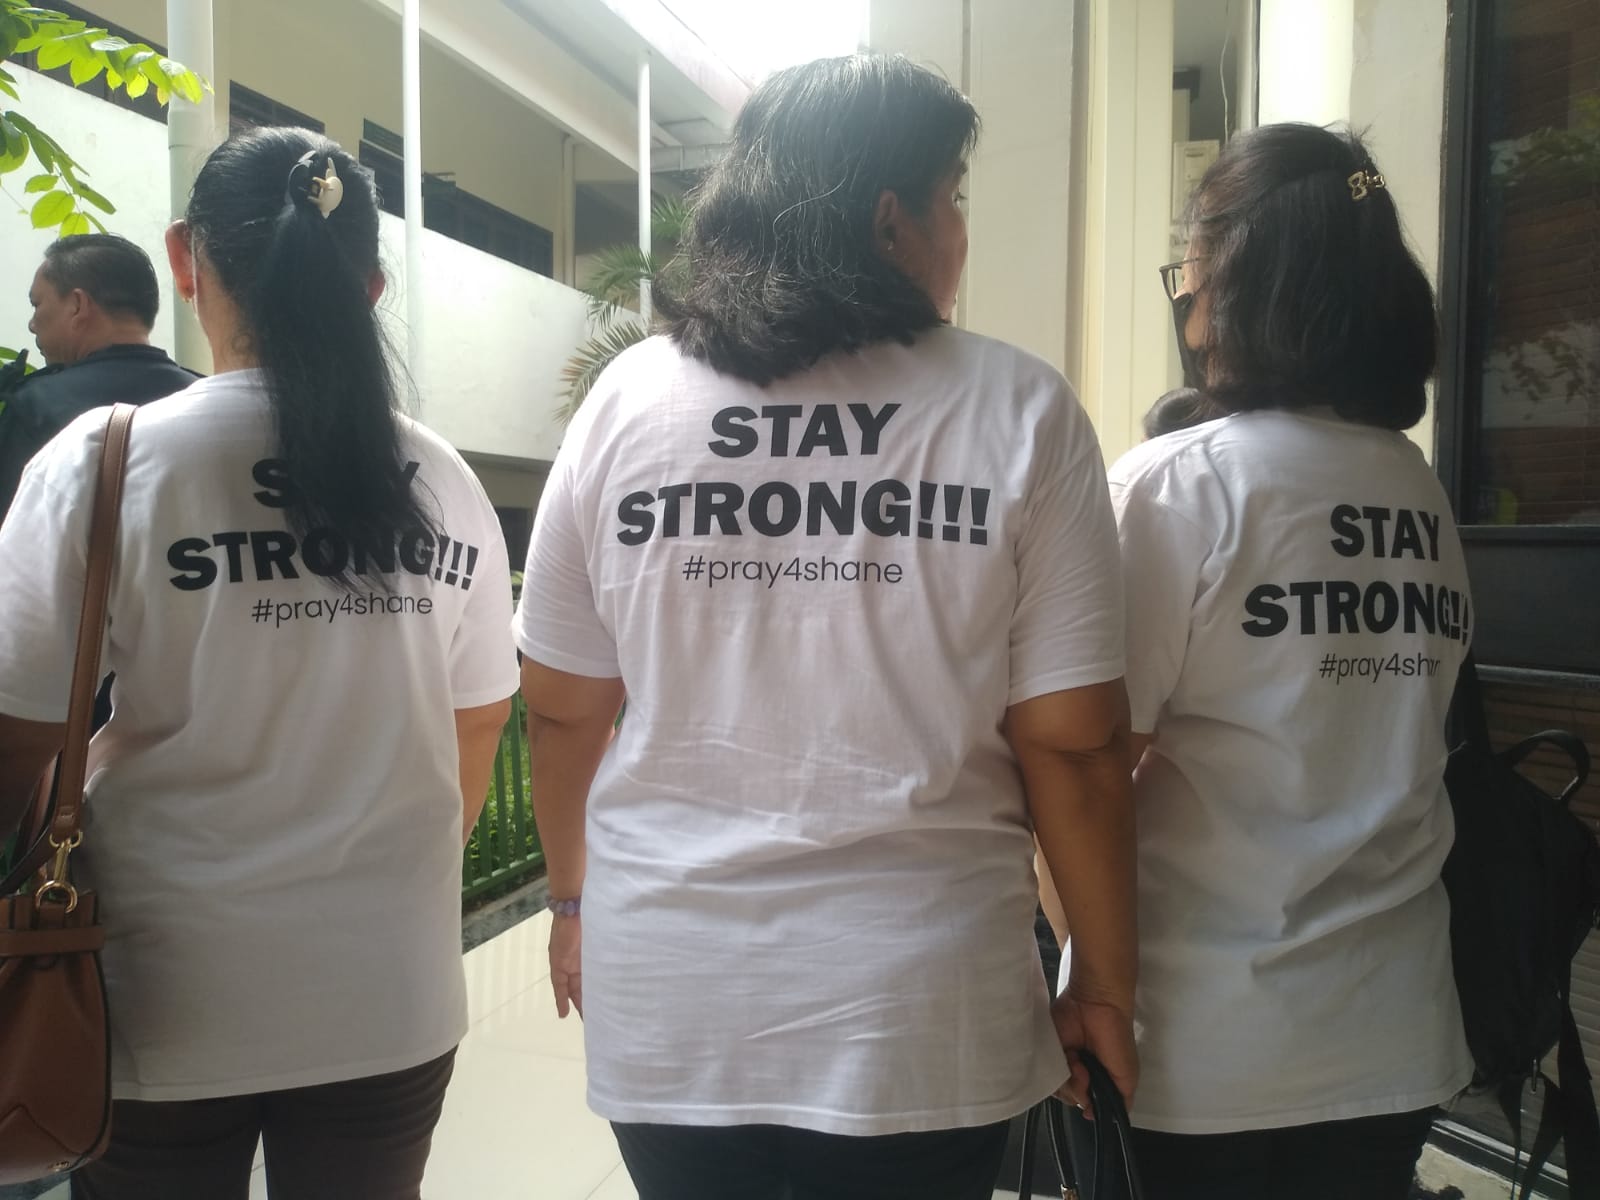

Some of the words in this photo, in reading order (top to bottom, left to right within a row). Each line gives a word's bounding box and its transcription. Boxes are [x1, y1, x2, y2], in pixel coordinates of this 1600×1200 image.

[707, 402, 902, 459] STAY
[616, 478, 991, 547] STRONG!!!
[1330, 503, 1440, 562] STAY
[167, 527, 480, 592] STRONG!!!
[682, 555, 903, 589] #pray4shane
[251, 592, 434, 629] #pray4shane
